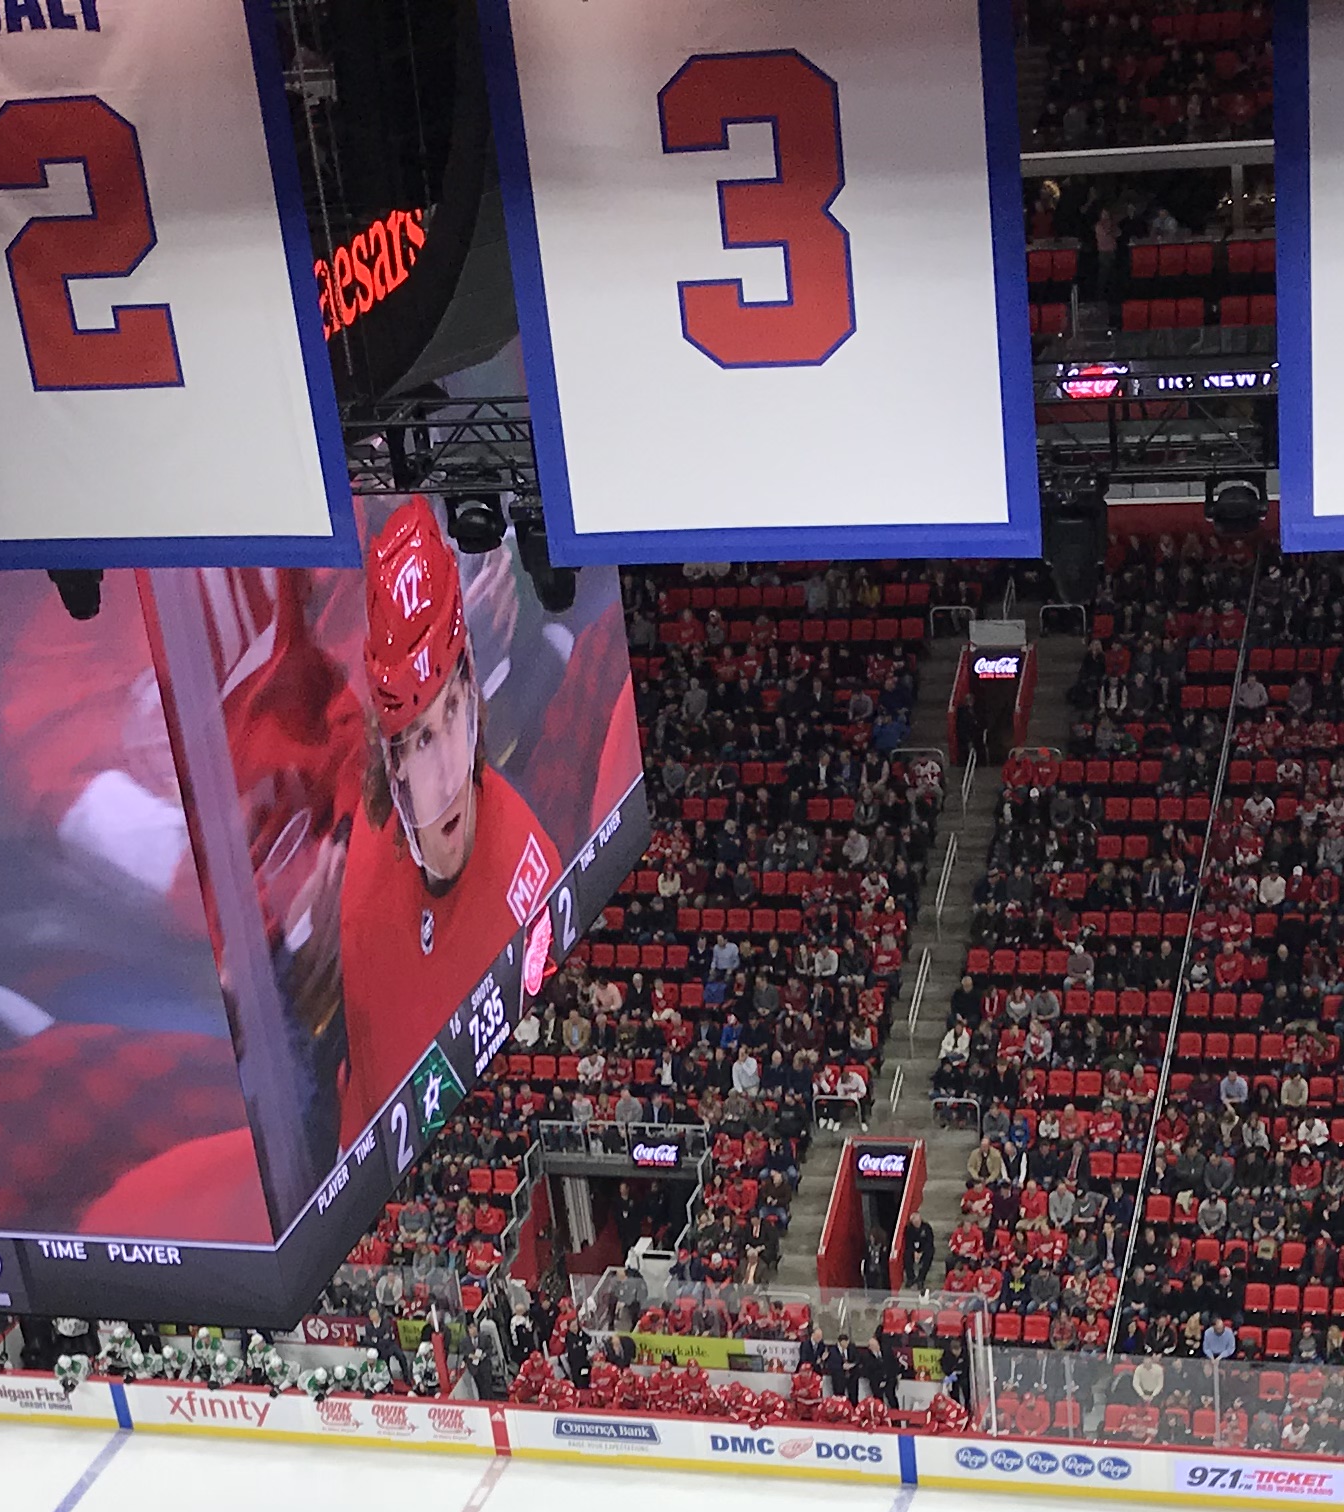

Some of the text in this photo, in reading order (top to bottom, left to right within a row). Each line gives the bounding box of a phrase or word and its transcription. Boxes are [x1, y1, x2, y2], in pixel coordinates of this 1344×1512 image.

[657, 48, 857, 369] 3
[314, 208, 426, 341] aesars
[599, 810, 622, 848] PLAYER
[558, 887, 576, 951] 2
[471, 972, 494, 1011] SHOTS
[449, 1011, 462, 1040] 16
[468, 986, 505, 1056] 7:35
[391, 1102, 414, 1174] 2
[318, 1129, 377, 1215] PLAYER TIME
[39, 1240, 182, 1266] TIME PLAYER
[166, 1391, 271, 1427] xfinity
[619, 1425, 650, 1438] Bank
[710, 1435, 883, 1463] DMC DOCS
[1187, 1466, 1243, 1489] 97.1
[1255, 1470, 1332, 1487] TICKET
